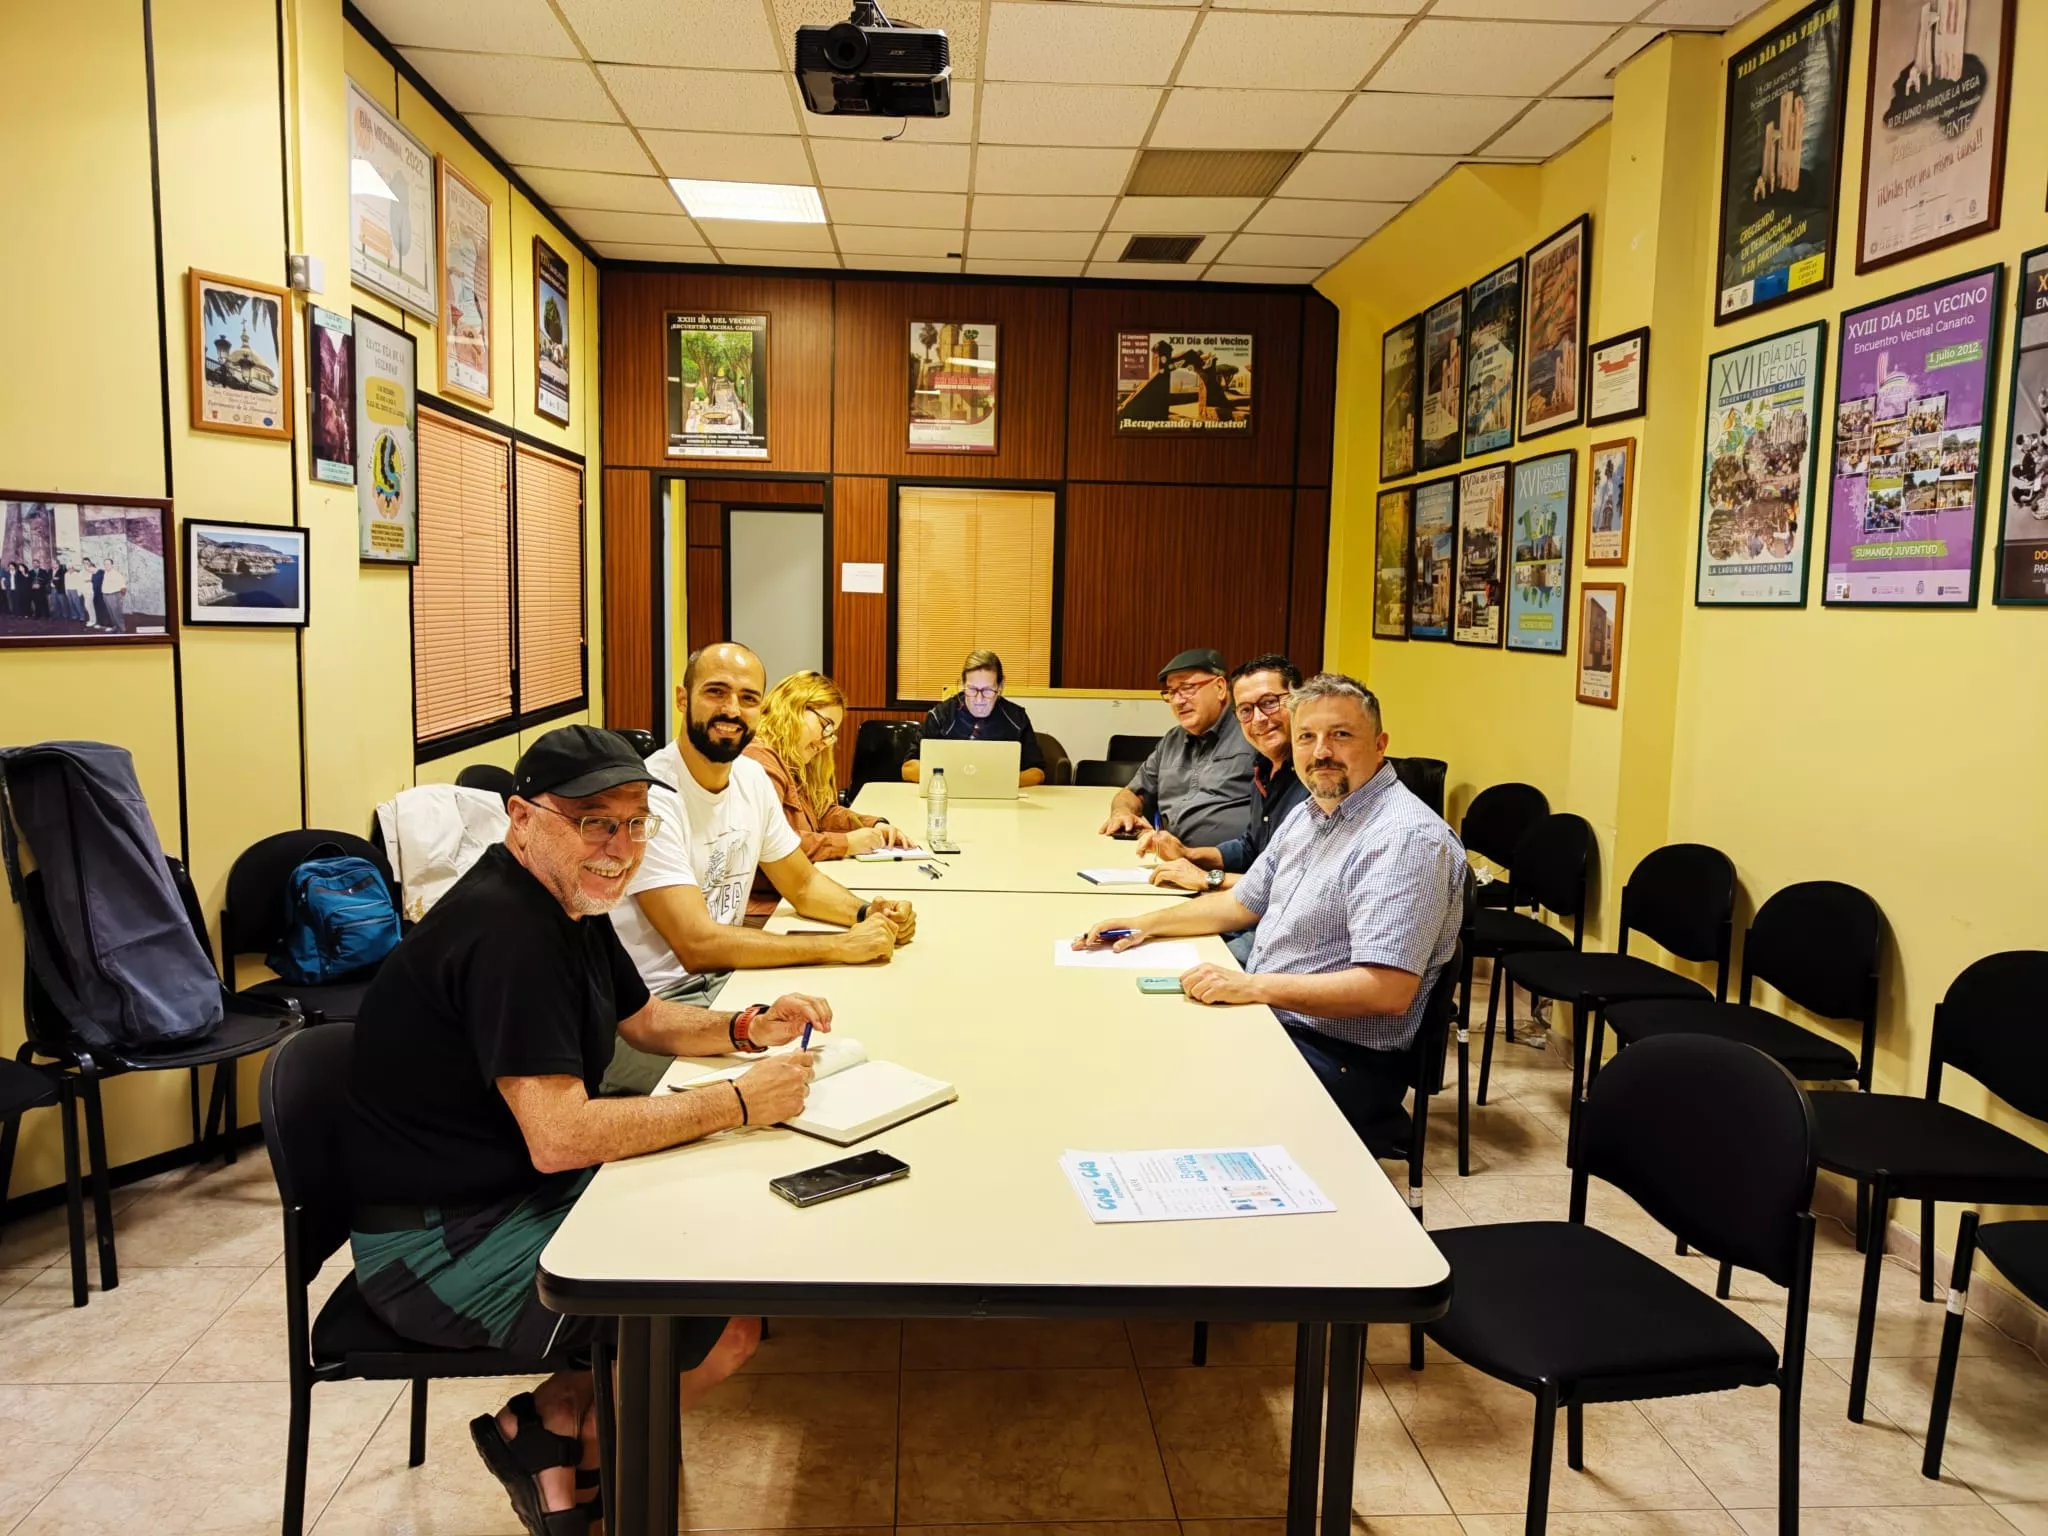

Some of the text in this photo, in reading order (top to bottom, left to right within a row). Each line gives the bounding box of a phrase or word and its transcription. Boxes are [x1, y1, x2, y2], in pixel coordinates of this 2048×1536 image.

[1779, 31, 1798, 54] DEL
[1902, 104, 1921, 125] JUNIO
[1926, 89, 1951, 110] PARQUE
[1952, 84, 1960, 98] LA
[1961, 75, 1980, 93] VEGA
[405, 147, 424, 179] 2022
[1740, 208, 1775, 244] CRECIENDO
[1741, 213, 1792, 261] EN DEMOCRACIA
[1747, 258, 1756, 272] EN
[1848, 287, 1987, 340] XVIII DÍA DEL VECINO
[1169, 336, 1249, 346] XXI Día del Vecino
[1854, 335, 1898, 354] Encuentro
[1900, 323, 1934, 342] Vecinal
[1929, 353, 1934, 363] 1
[1935, 348, 1955, 364] julio
[1957, 342, 1979, 355] 2012
[1720, 339, 1807, 397] XVII DÍA DEL
[1762, 358, 1807, 385] VECINO
[1120, 418, 1247, 430] ¡Recuperando lo nuestro!
[1520, 467, 1540, 499] XVI
[1540, 477, 1566, 495] VECINO
[1856, 544, 1938, 558] SUMANDO JUVENTUD
[1709, 563, 1793, 575] LA LAGUNA PARTICIPATIVA
